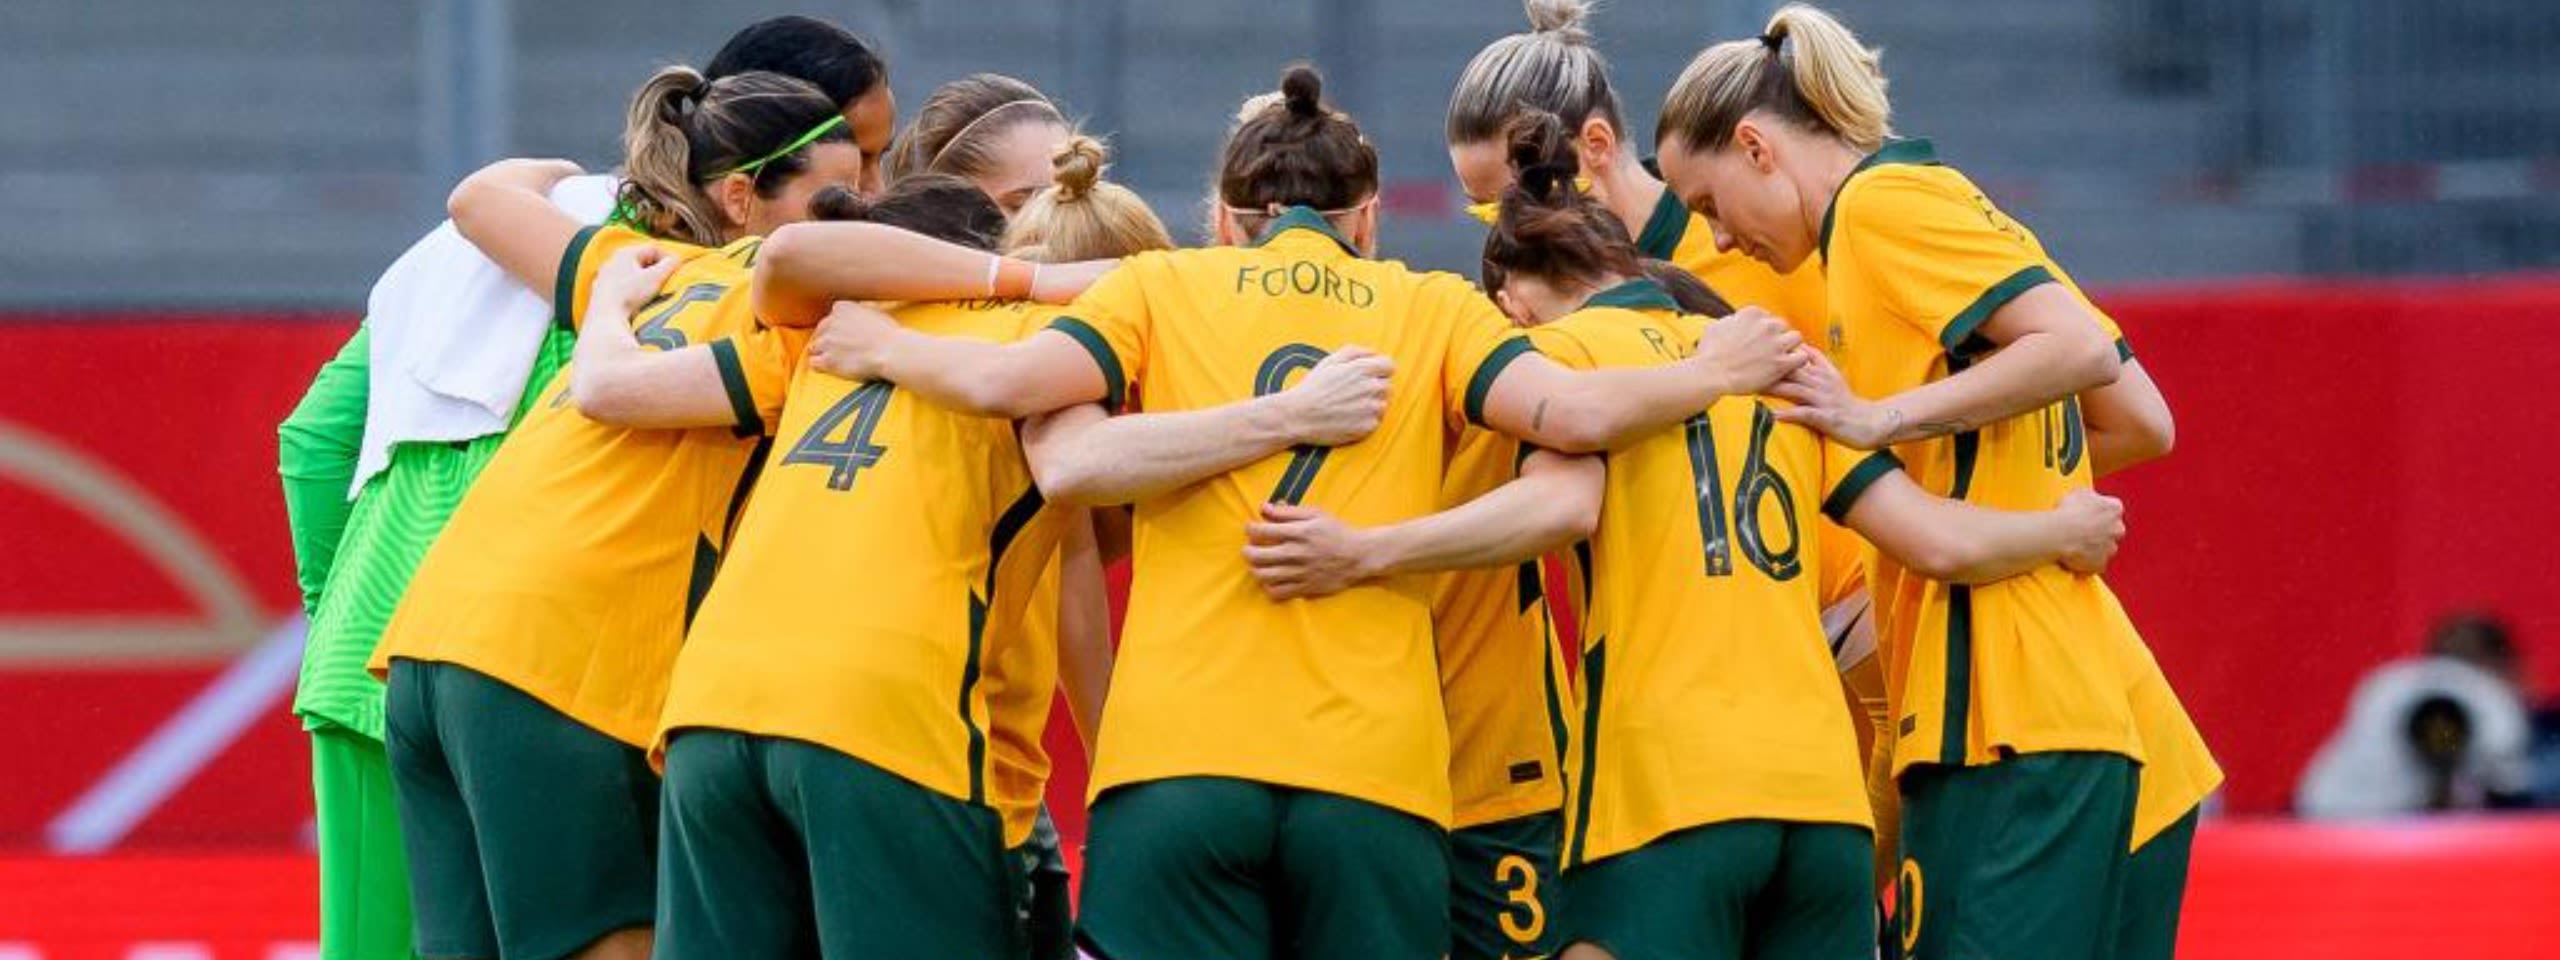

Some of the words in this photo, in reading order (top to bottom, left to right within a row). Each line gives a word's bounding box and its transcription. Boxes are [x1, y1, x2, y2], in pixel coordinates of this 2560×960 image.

[1237, 261, 1373, 308] FOORD
[780, 378, 897, 491] 4
[1684, 400, 1802, 581] 16
[1495, 854, 1546, 943] 3
